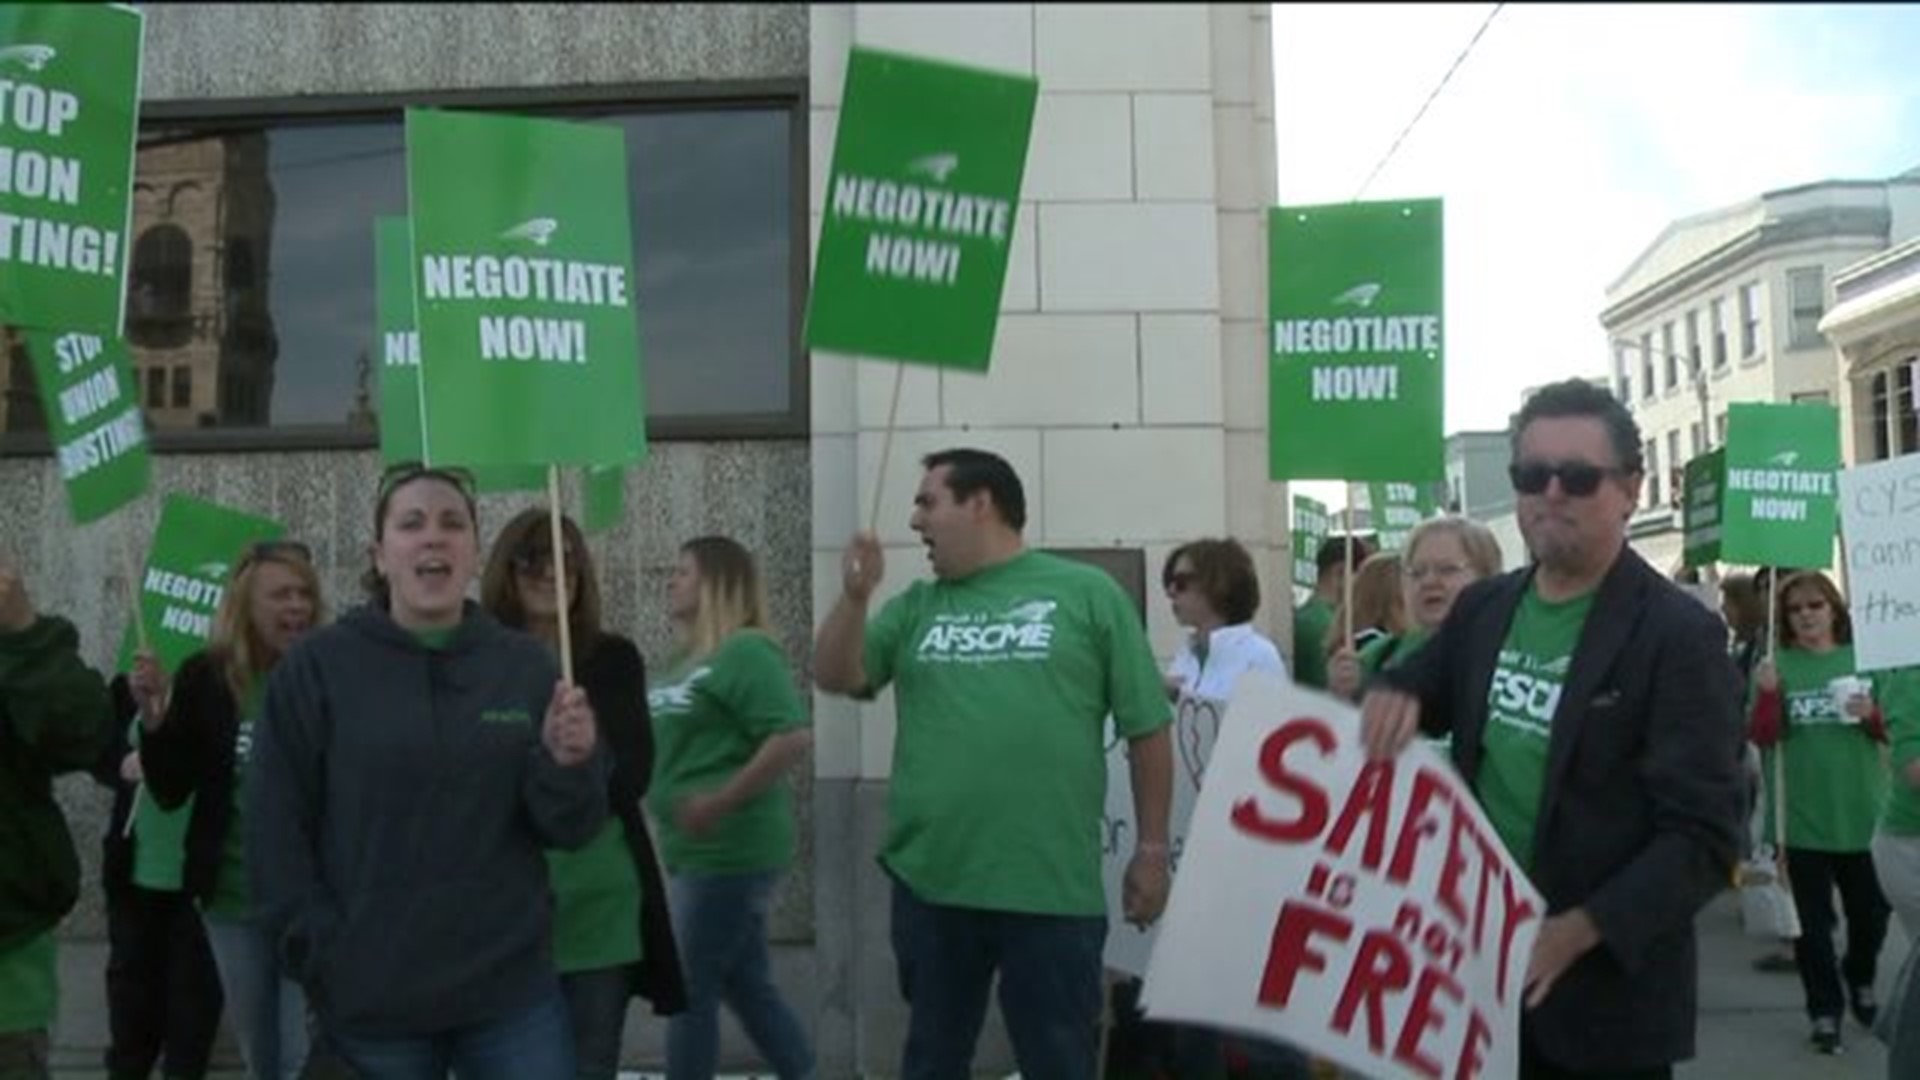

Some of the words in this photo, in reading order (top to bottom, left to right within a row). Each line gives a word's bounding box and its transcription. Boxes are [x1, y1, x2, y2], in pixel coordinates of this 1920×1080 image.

[834, 174, 1008, 243] NEGOTIATE
[0, 212, 118, 276] TING!
[867, 233, 960, 287] NOW!
[423, 254, 627, 305] NEGOTIATE
[480, 315, 586, 363] NOW!
[1275, 316, 1438, 353] NEGOTIATE
[1312, 366, 1398, 400] NOW!
[1728, 469, 1834, 494] NEGOTIATE
[1752, 497, 1807, 520] NOW!
[918, 623, 1054, 652] AFSCME
[1230, 717, 1537, 1005] SAFETY
[1257, 898, 1493, 1080] FREE
